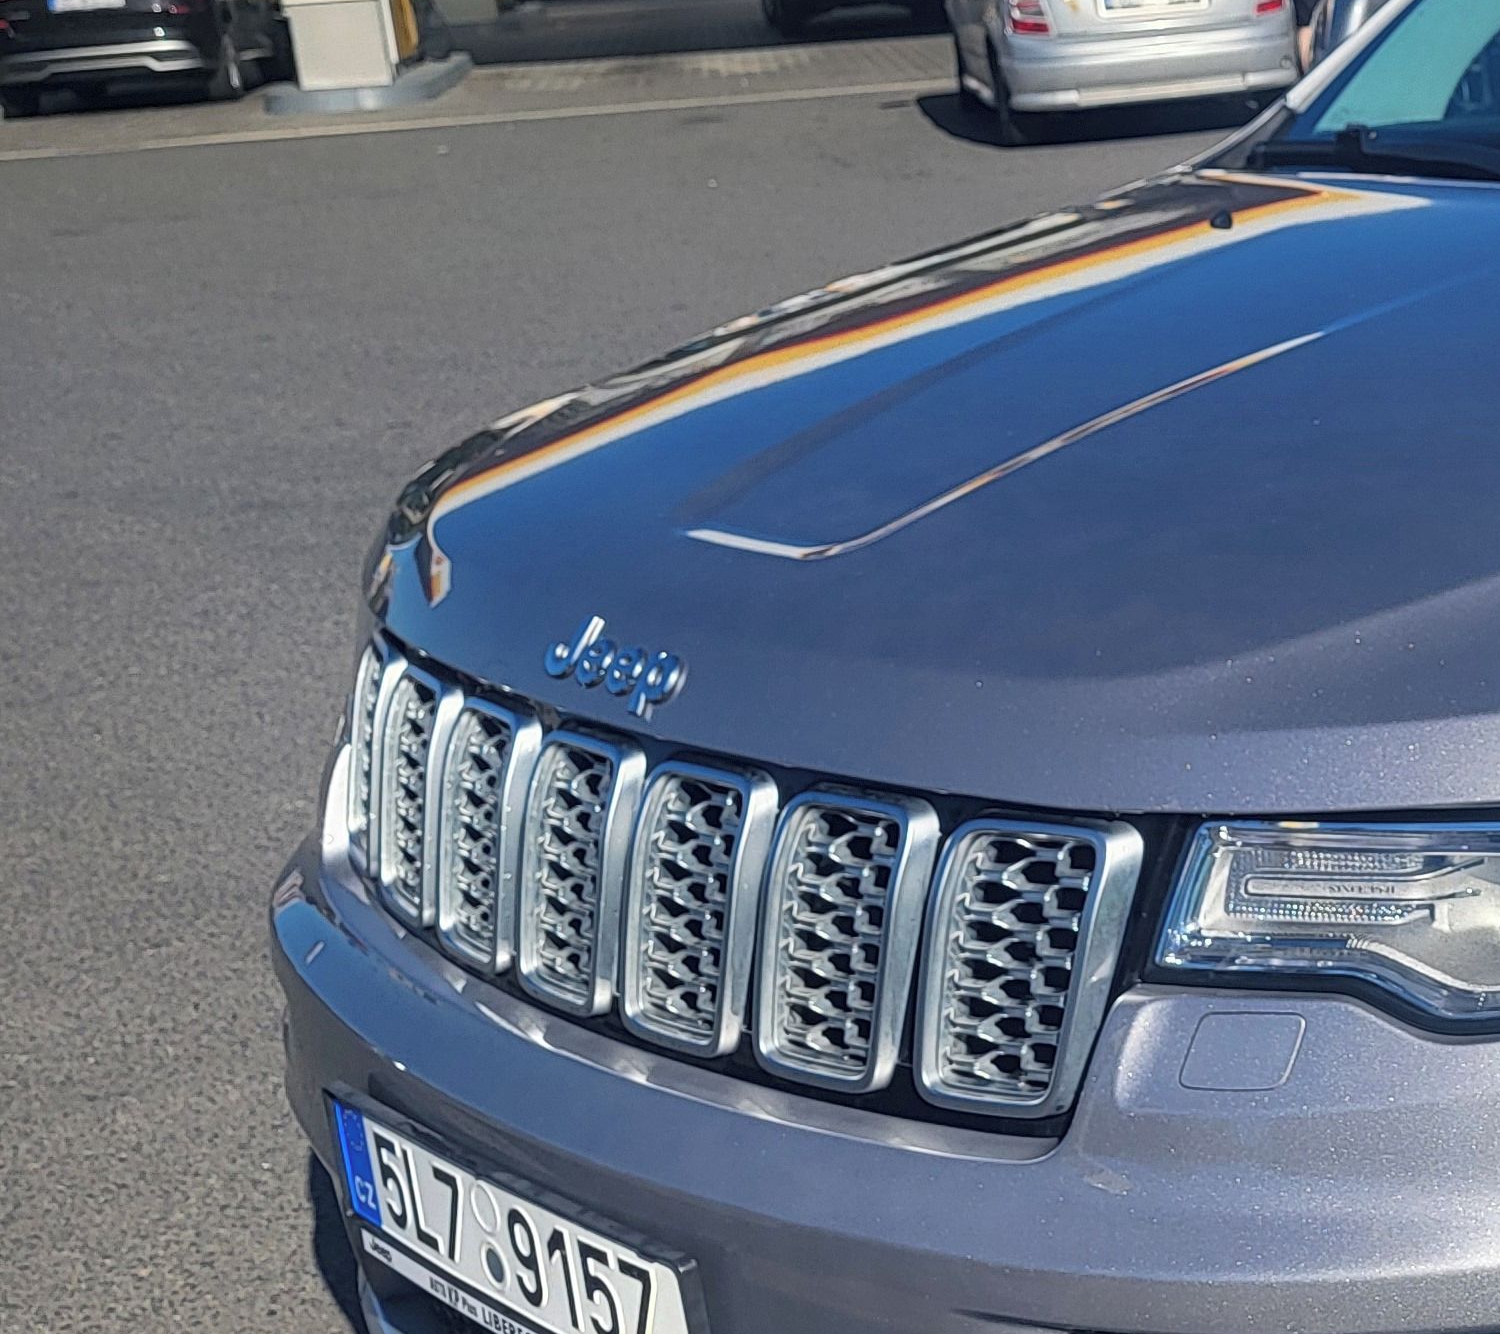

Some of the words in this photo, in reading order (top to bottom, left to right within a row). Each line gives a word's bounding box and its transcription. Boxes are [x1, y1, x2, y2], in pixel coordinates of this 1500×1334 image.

[544, 615, 685, 718] Jeep
[354, 1175, 377, 1210] CZ
[373, 1129, 463, 1263] 5L7
[369, 1238, 393, 1263] Jeep
